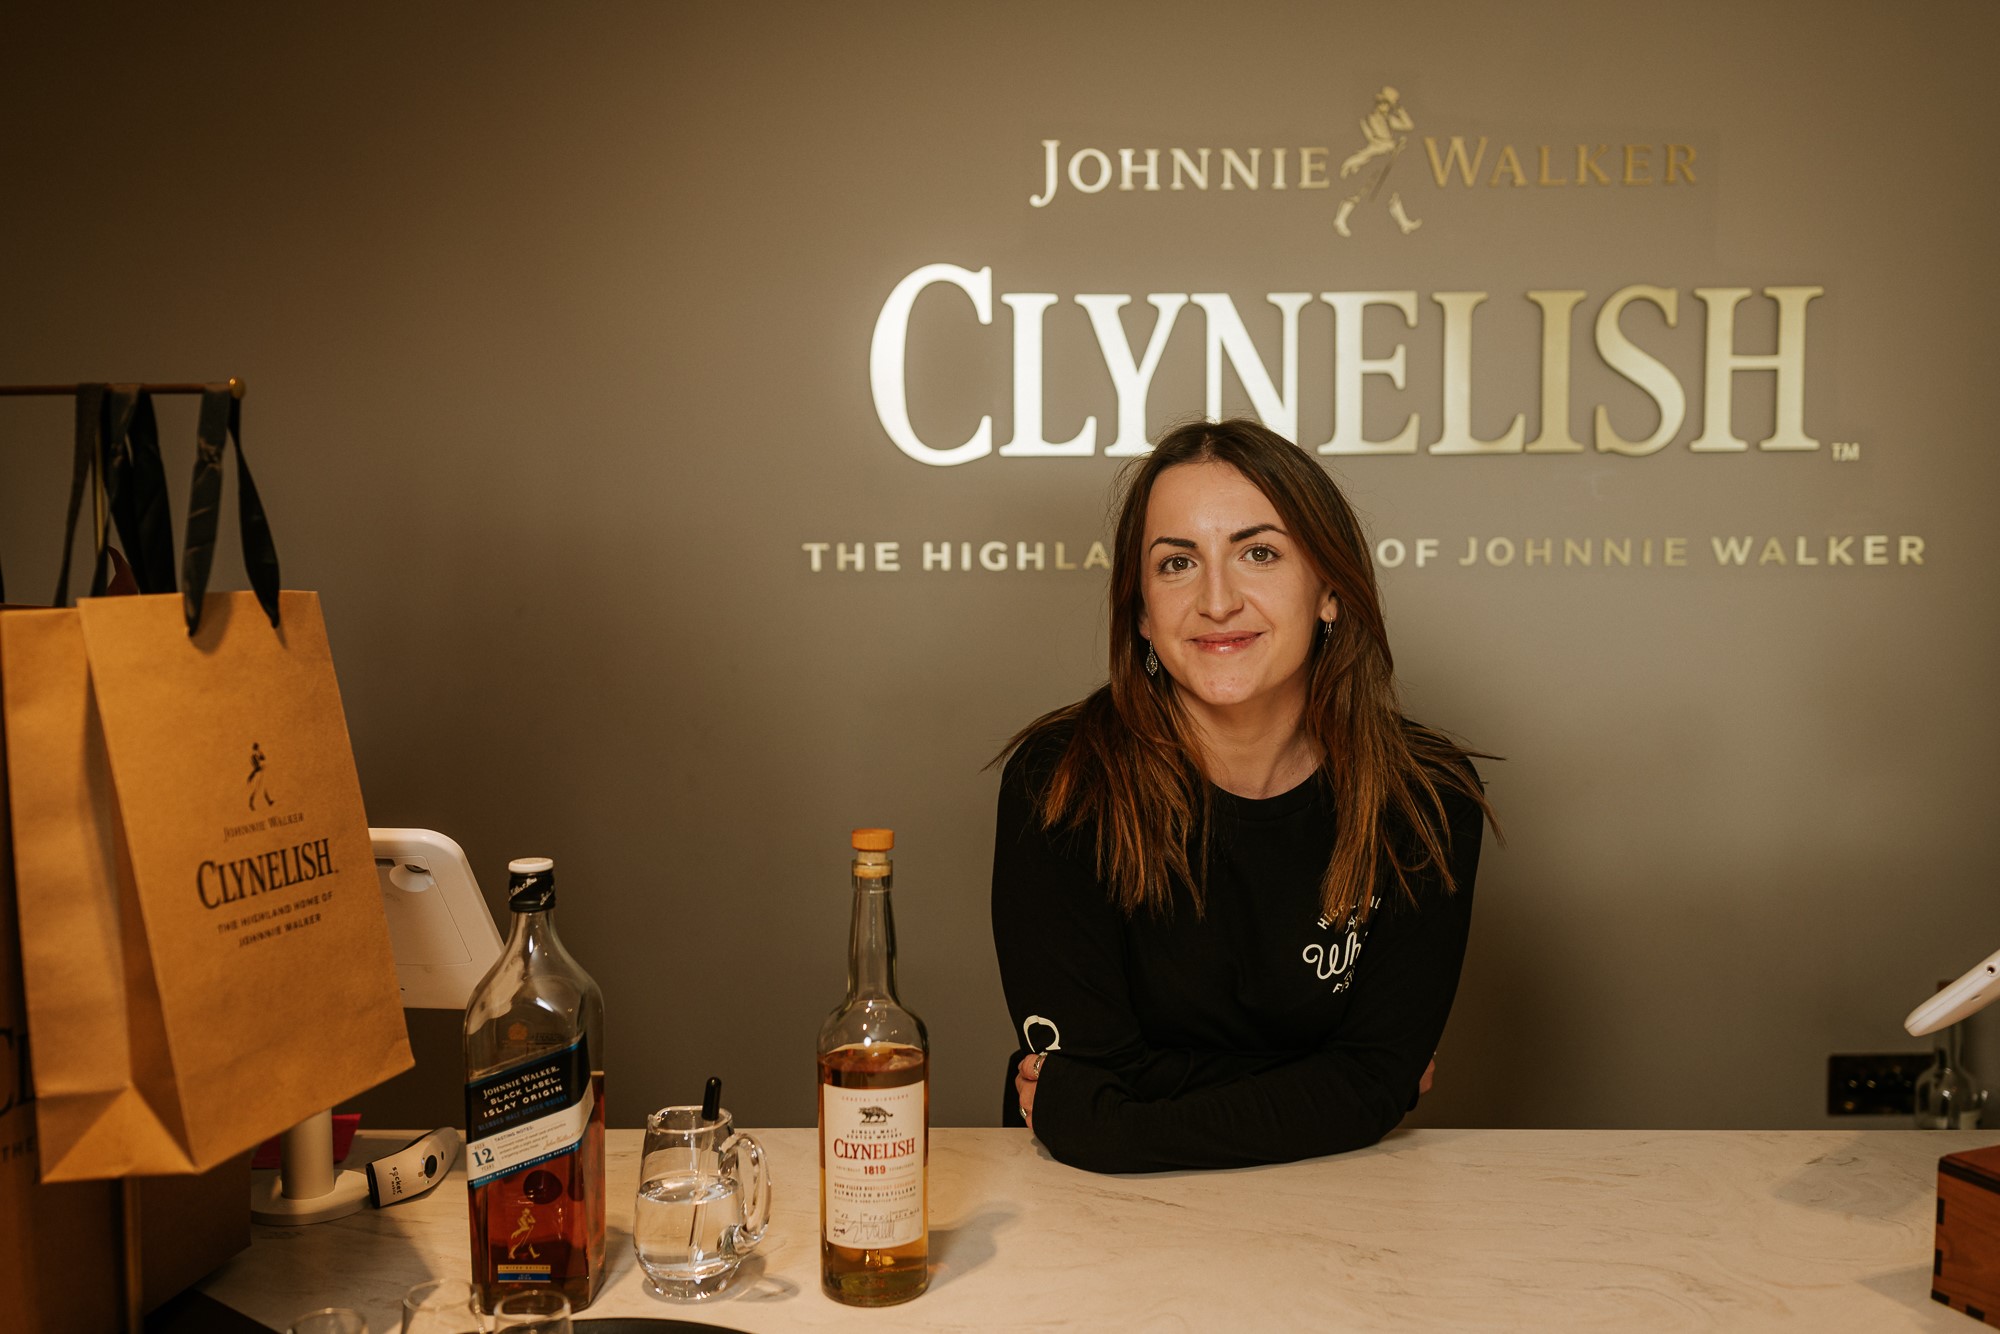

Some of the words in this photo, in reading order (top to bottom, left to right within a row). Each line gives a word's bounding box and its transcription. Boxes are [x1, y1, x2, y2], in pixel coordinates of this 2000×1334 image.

[1029, 139, 1331, 208] JOHNNIE
[1423, 134, 1699, 188] WALKER
[869, 262, 1825, 467] CLYNELISH
[802, 541, 901, 572] THE
[922, 541, 1111, 572] HIGHLA
[1376, 537, 1440, 567] OF
[1458, 536, 1690, 567] JOHNNIE
[1711, 535, 1926, 566] WALKER
[223, 820, 266, 842] JOHNNIE
[268, 812, 304, 828] WALKER
[196, 837, 334, 910] CLYNELISH
[218, 920, 238, 934] THE
[240, 904, 292, 926] HIGHLAND
[293, 895, 319, 910] HOME
[321, 890, 333, 902] OF
[239, 925, 282, 948] JOHNNIE
[283, 913, 321, 931] WALKER
[483, 1080, 521, 1100] JOHNNIE
[483, 1101, 517, 1118] ISLAY
[522, 1085, 563, 1104] ORIGIN
[490, 1089, 522, 1105] BLACK
[472, 1147, 494, 1167] 12
[833, 1137, 916, 1160] CLYNELISH
[863, 1165, 886, 1175] 1819
